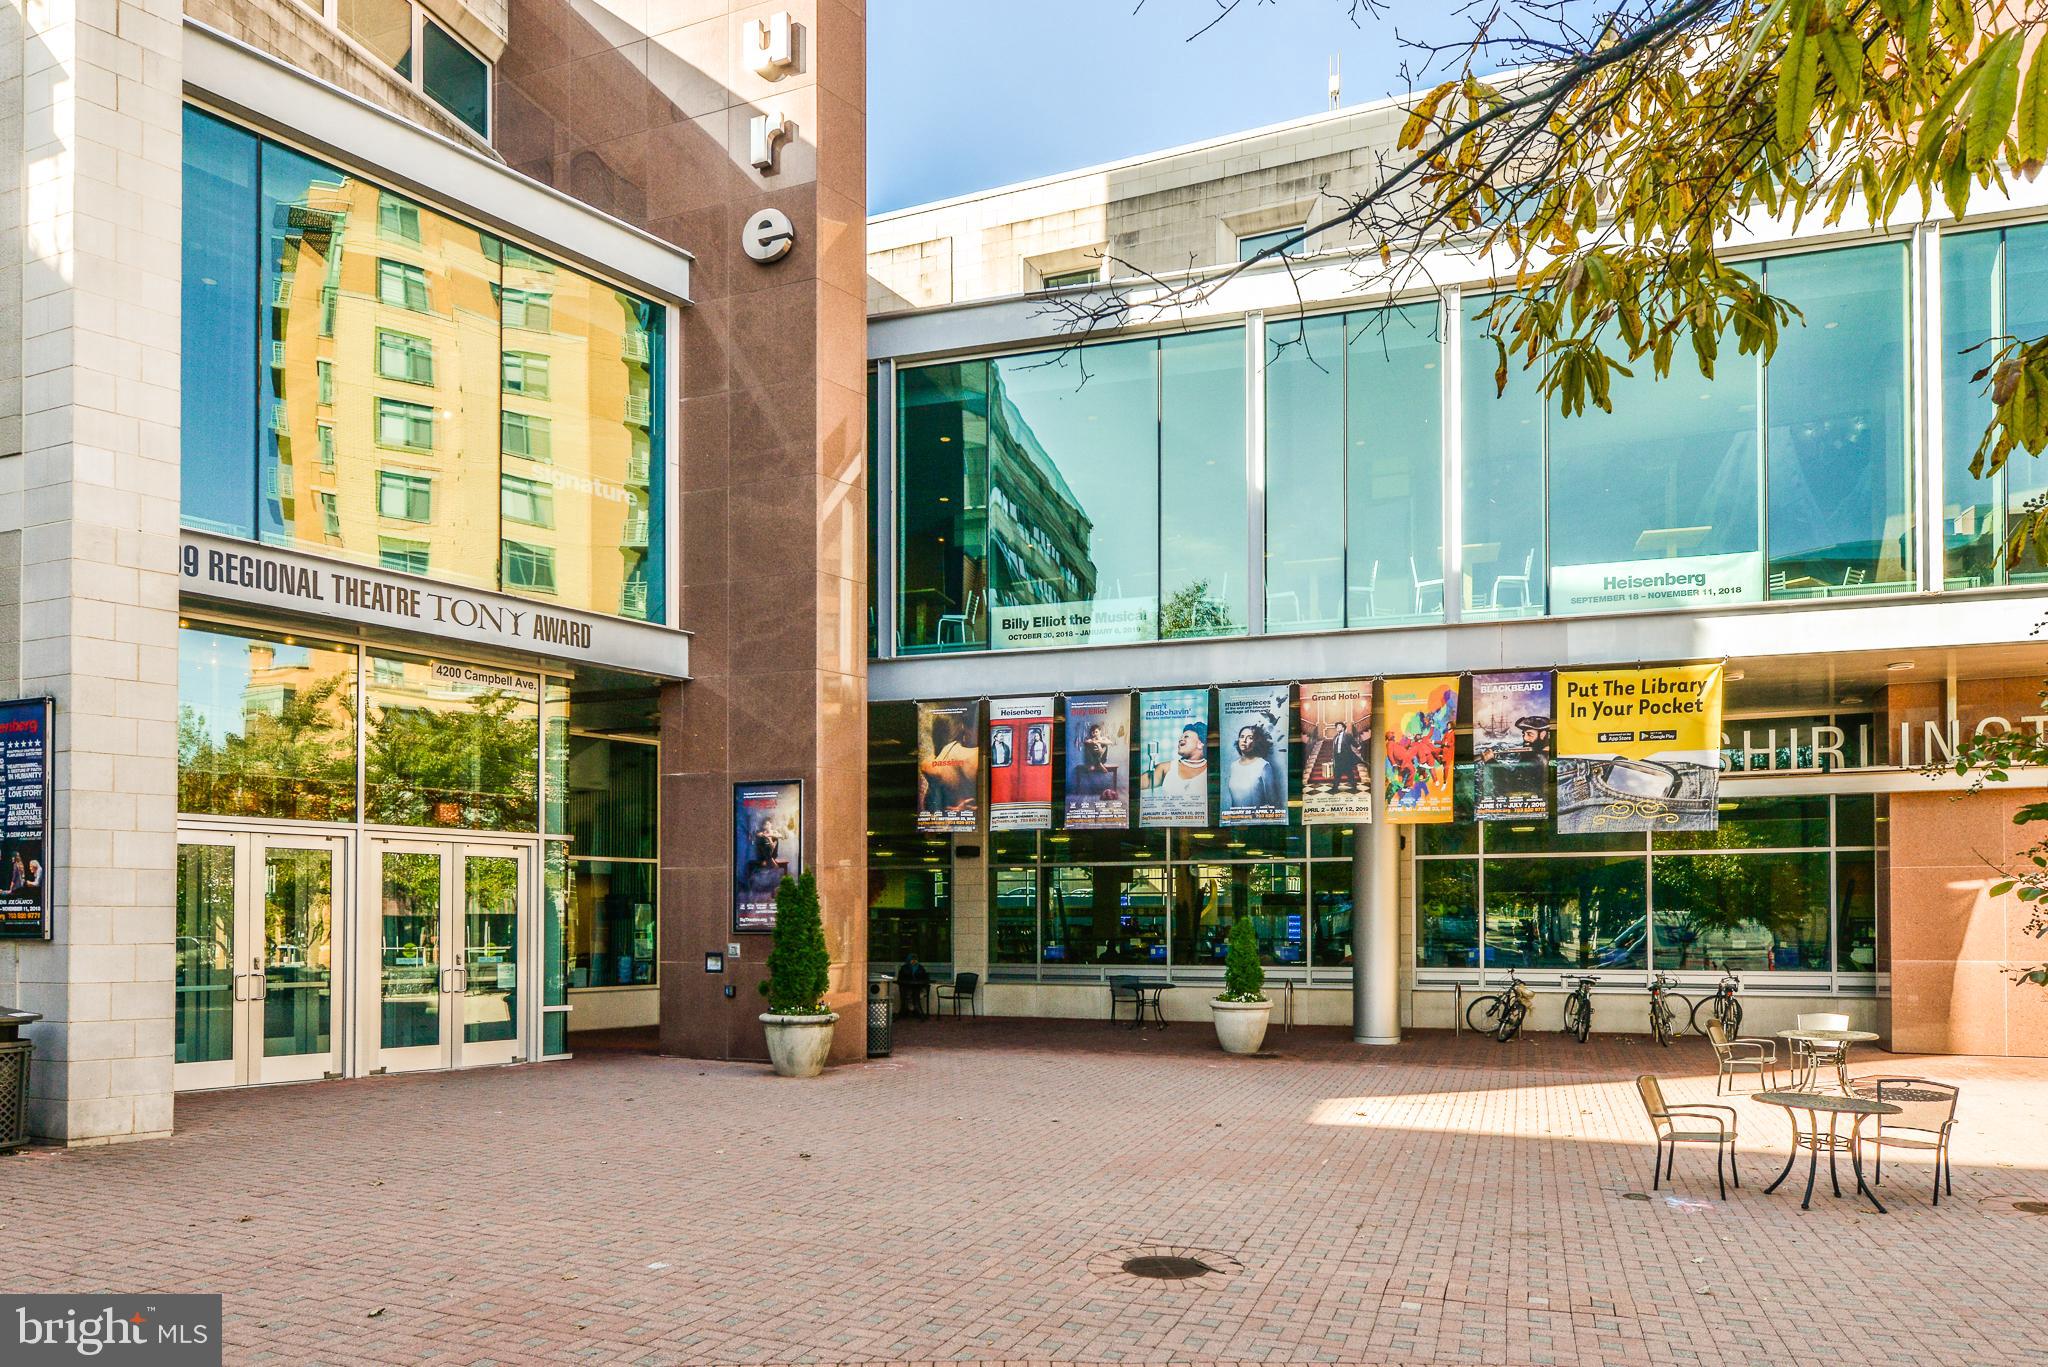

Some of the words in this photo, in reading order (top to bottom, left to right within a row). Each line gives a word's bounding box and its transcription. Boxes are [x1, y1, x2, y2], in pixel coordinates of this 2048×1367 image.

[532, 464, 638, 506] signature
[1604, 573, 1706, 590] Heisenberg
[179, 545, 199, 577] 9
[209, 550, 324, 600] REGIONAL
[331, 574, 421, 618] THEATRE
[427, 593, 527, 636] TONY
[1571, 595, 1625, 604] SEPTEMBER
[1648, 590, 1699, 599] NOVEMBER
[1703, 589, 1716, 597] 11,
[1719, 587, 1742, 595] 2018
[1002, 618, 1029, 631] Billy
[1033, 616, 1066, 628] Elliot
[1070, 614, 1091, 625] the
[1096, 609, 1146, 624] Musical
[1008, 633, 1042, 641] OCTOBER
[1080, 628, 1112, 636] JANUARY
[436, 665, 461, 679] 4200
[464, 670, 512, 686] Campbell
[515, 678, 537, 690] Ave.
[1481, 683, 1543, 693] BLACKBEARD
[1568, 682, 1598, 698] Put
[1604, 680, 1635, 696] The
[1642, 678, 1707, 696] Library
[1312, 693, 1336, 701] Grand
[1146, 708, 1191, 716] misbehavin'
[1571, 703, 1586, 717] In
[1593, 701, 1633, 720] Your
[1639, 697, 1703, 714] Pocket
[932, 760, 964, 768] passion
